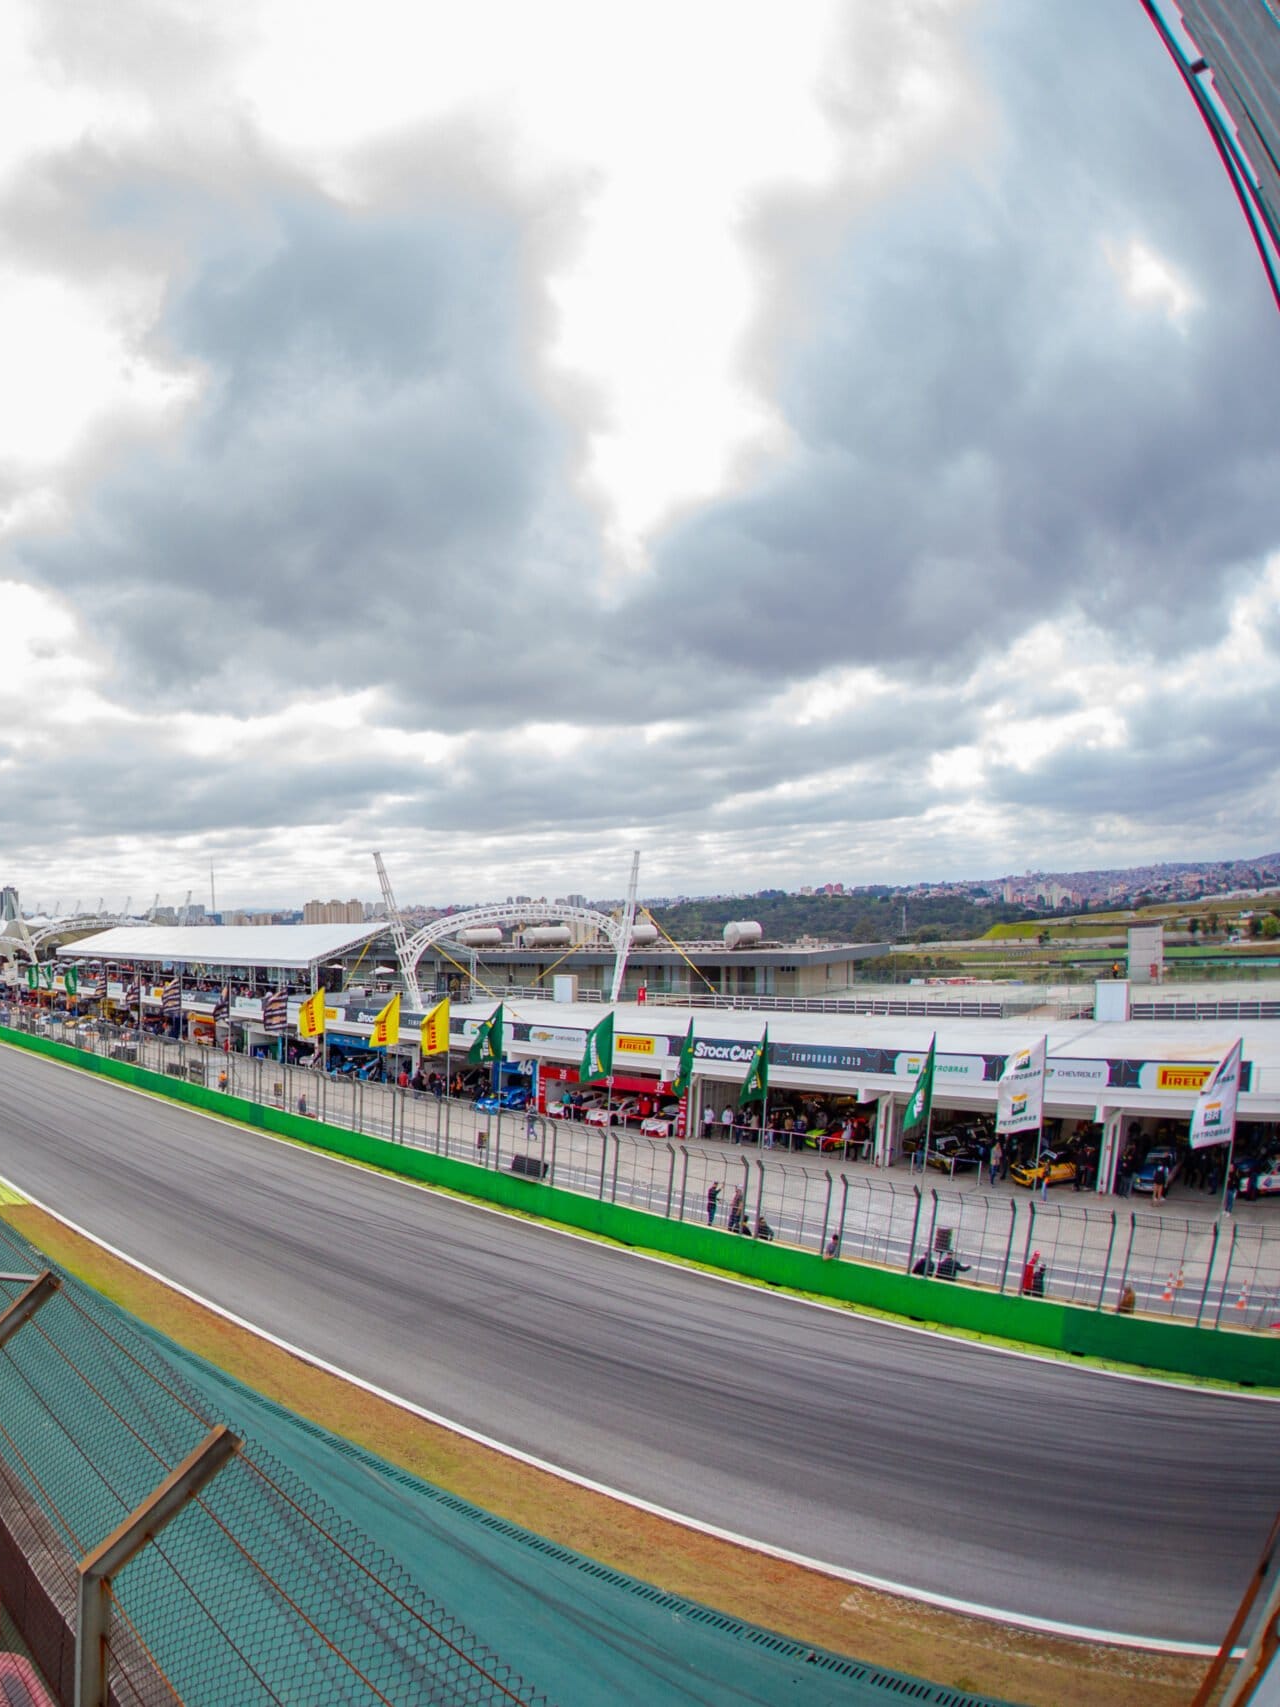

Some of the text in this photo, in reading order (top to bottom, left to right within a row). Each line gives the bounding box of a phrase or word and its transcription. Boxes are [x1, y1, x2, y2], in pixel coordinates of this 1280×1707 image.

[619, 1038, 651, 1052] PIRELLI
[694, 1042, 754, 1061] STOCK CAR
[791, 1052, 862, 1066] TEMPORADA 2019
[517, 1060, 533, 1075] 46
[1057, 1070, 1102, 1078] CHEVROLET
